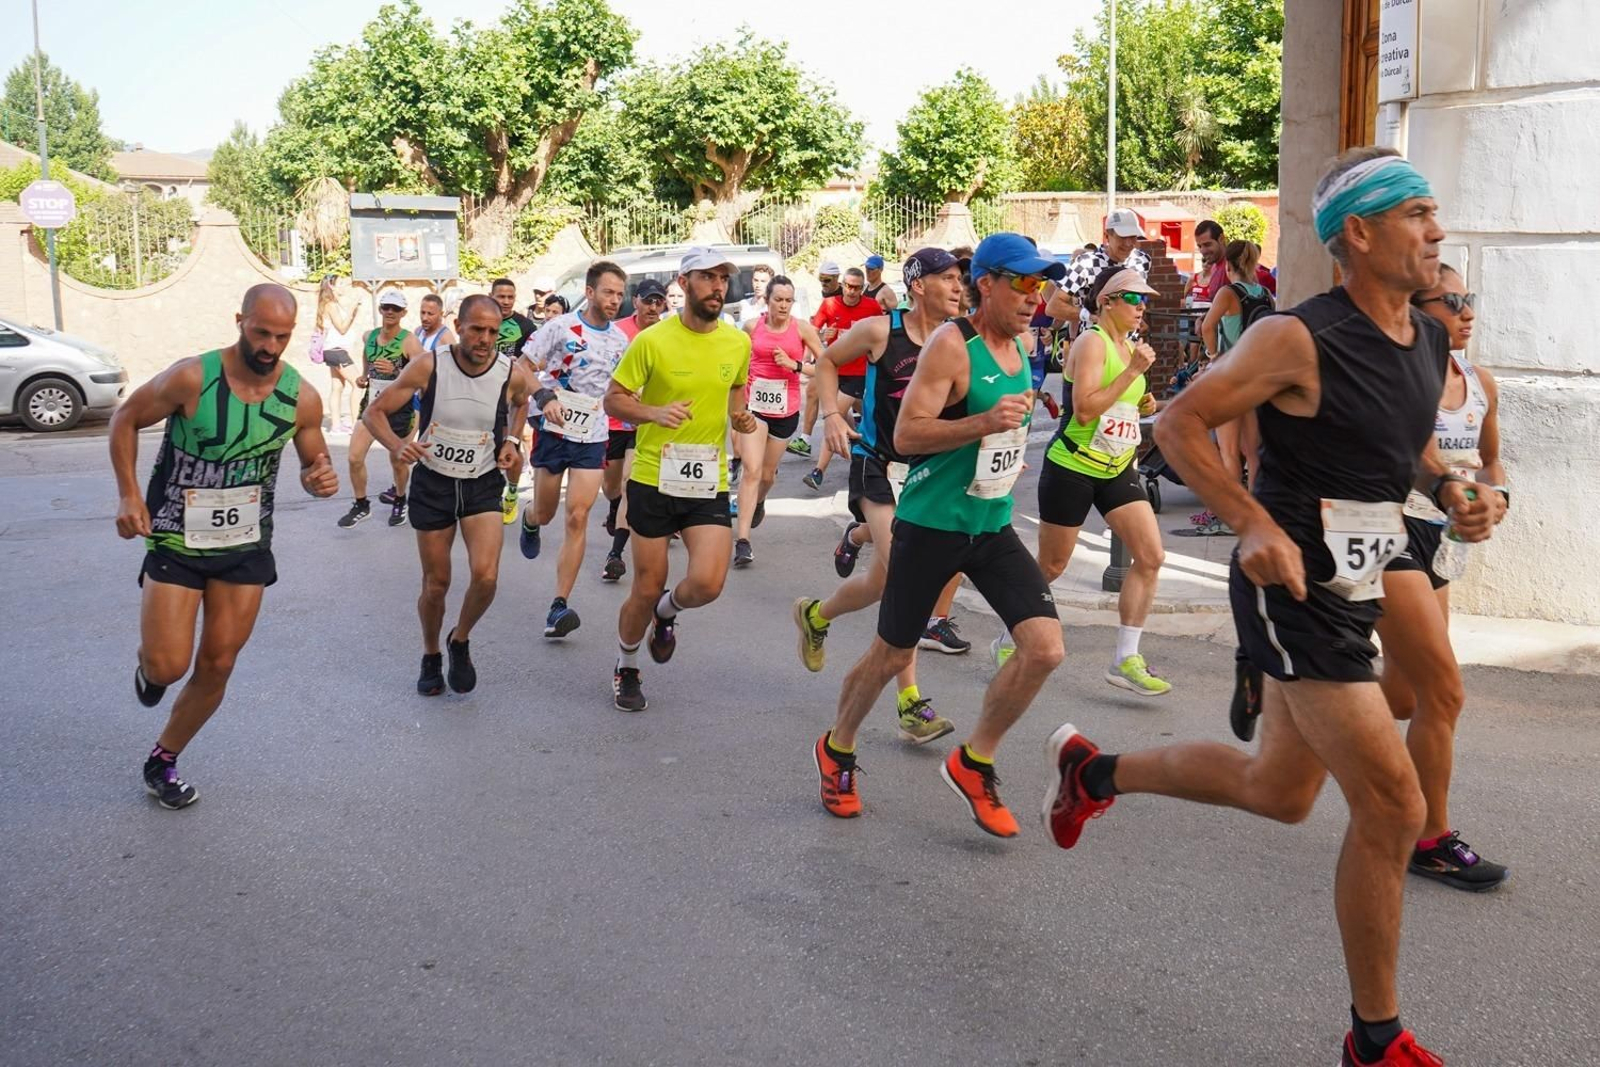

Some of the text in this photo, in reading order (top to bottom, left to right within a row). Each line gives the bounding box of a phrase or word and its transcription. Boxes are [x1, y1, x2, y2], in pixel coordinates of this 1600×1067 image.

[28, 198, 69, 210] STOP
[755, 390, 782, 403] 3036
[561, 408, 589, 425] 077
[1103, 418, 1137, 440] 2173
[434, 443, 475, 464] 3028
[990, 449, 1020, 473] 505
[680, 461, 703, 479] 46
[211, 507, 239, 528] 56
